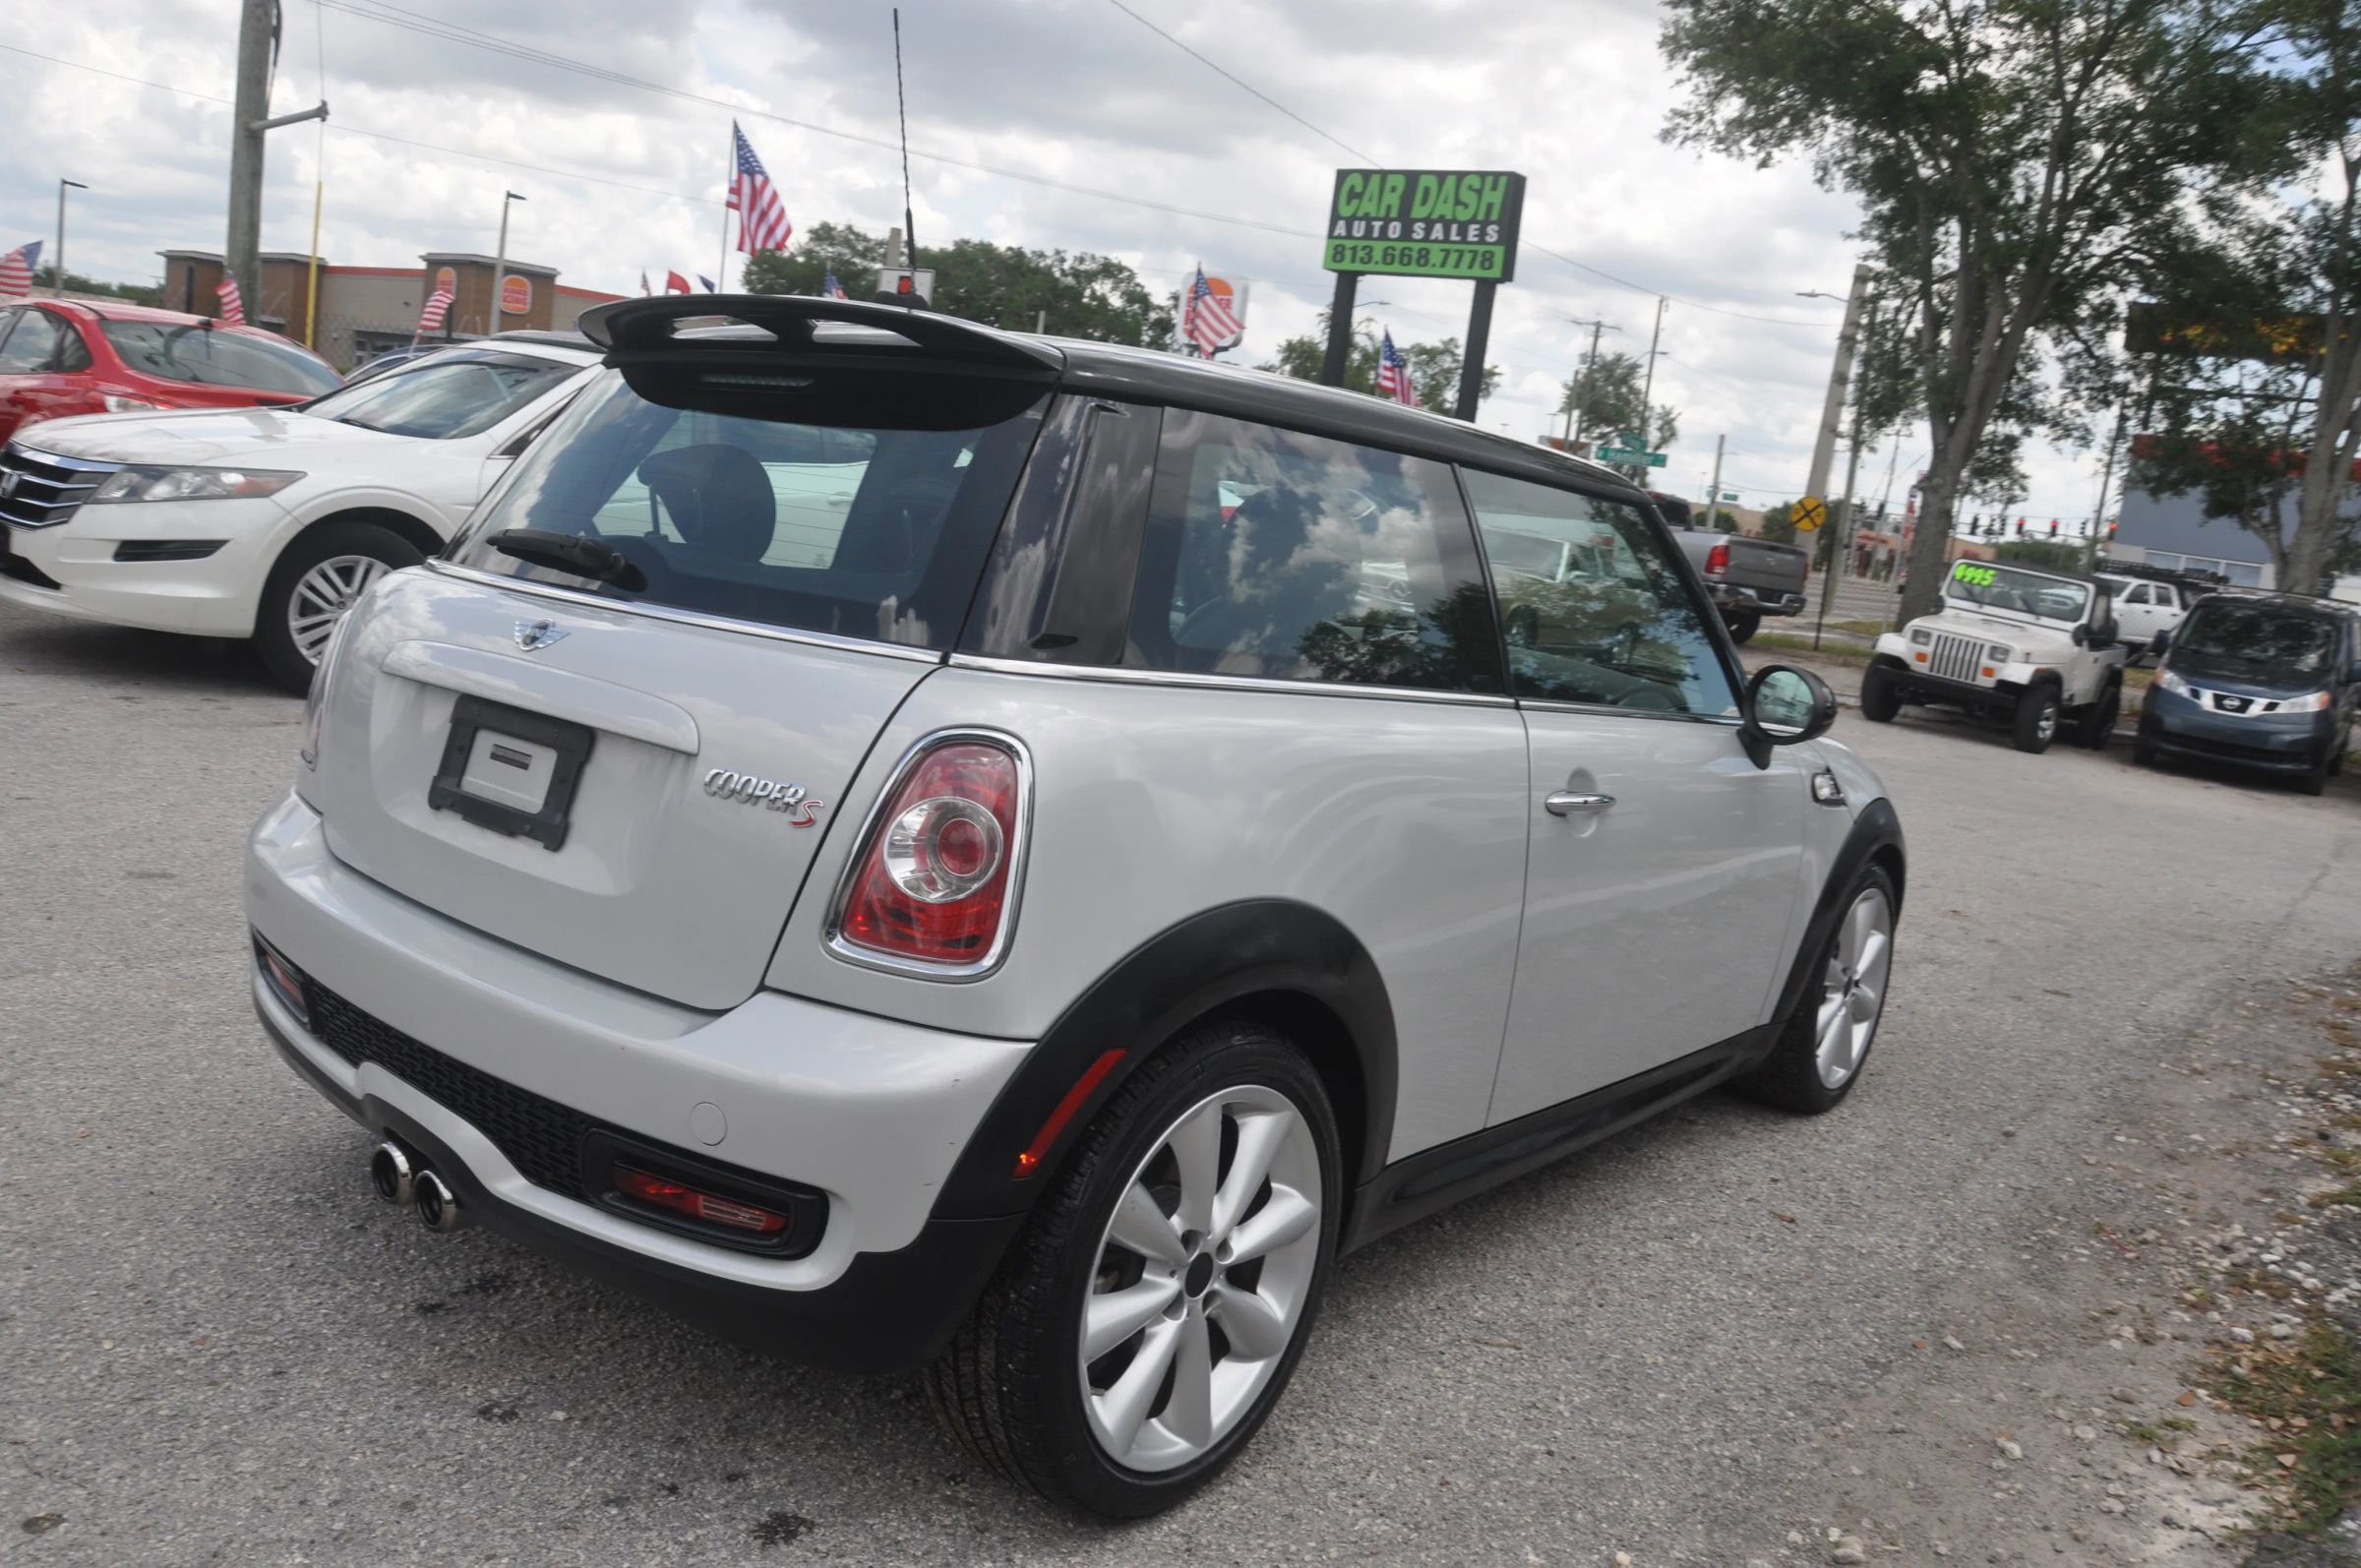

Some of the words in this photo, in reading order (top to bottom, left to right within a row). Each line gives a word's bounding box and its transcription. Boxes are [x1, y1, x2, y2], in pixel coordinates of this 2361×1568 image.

[1338, 173, 1406, 217] CAR
[1411, 175, 1507, 220] DASH
[1333, 219, 1402, 238] AUTO
[1412, 222, 1499, 242] SALES
[1332, 244, 1495, 271] 813.668.7778
[703, 768, 806, 815] COOPER
